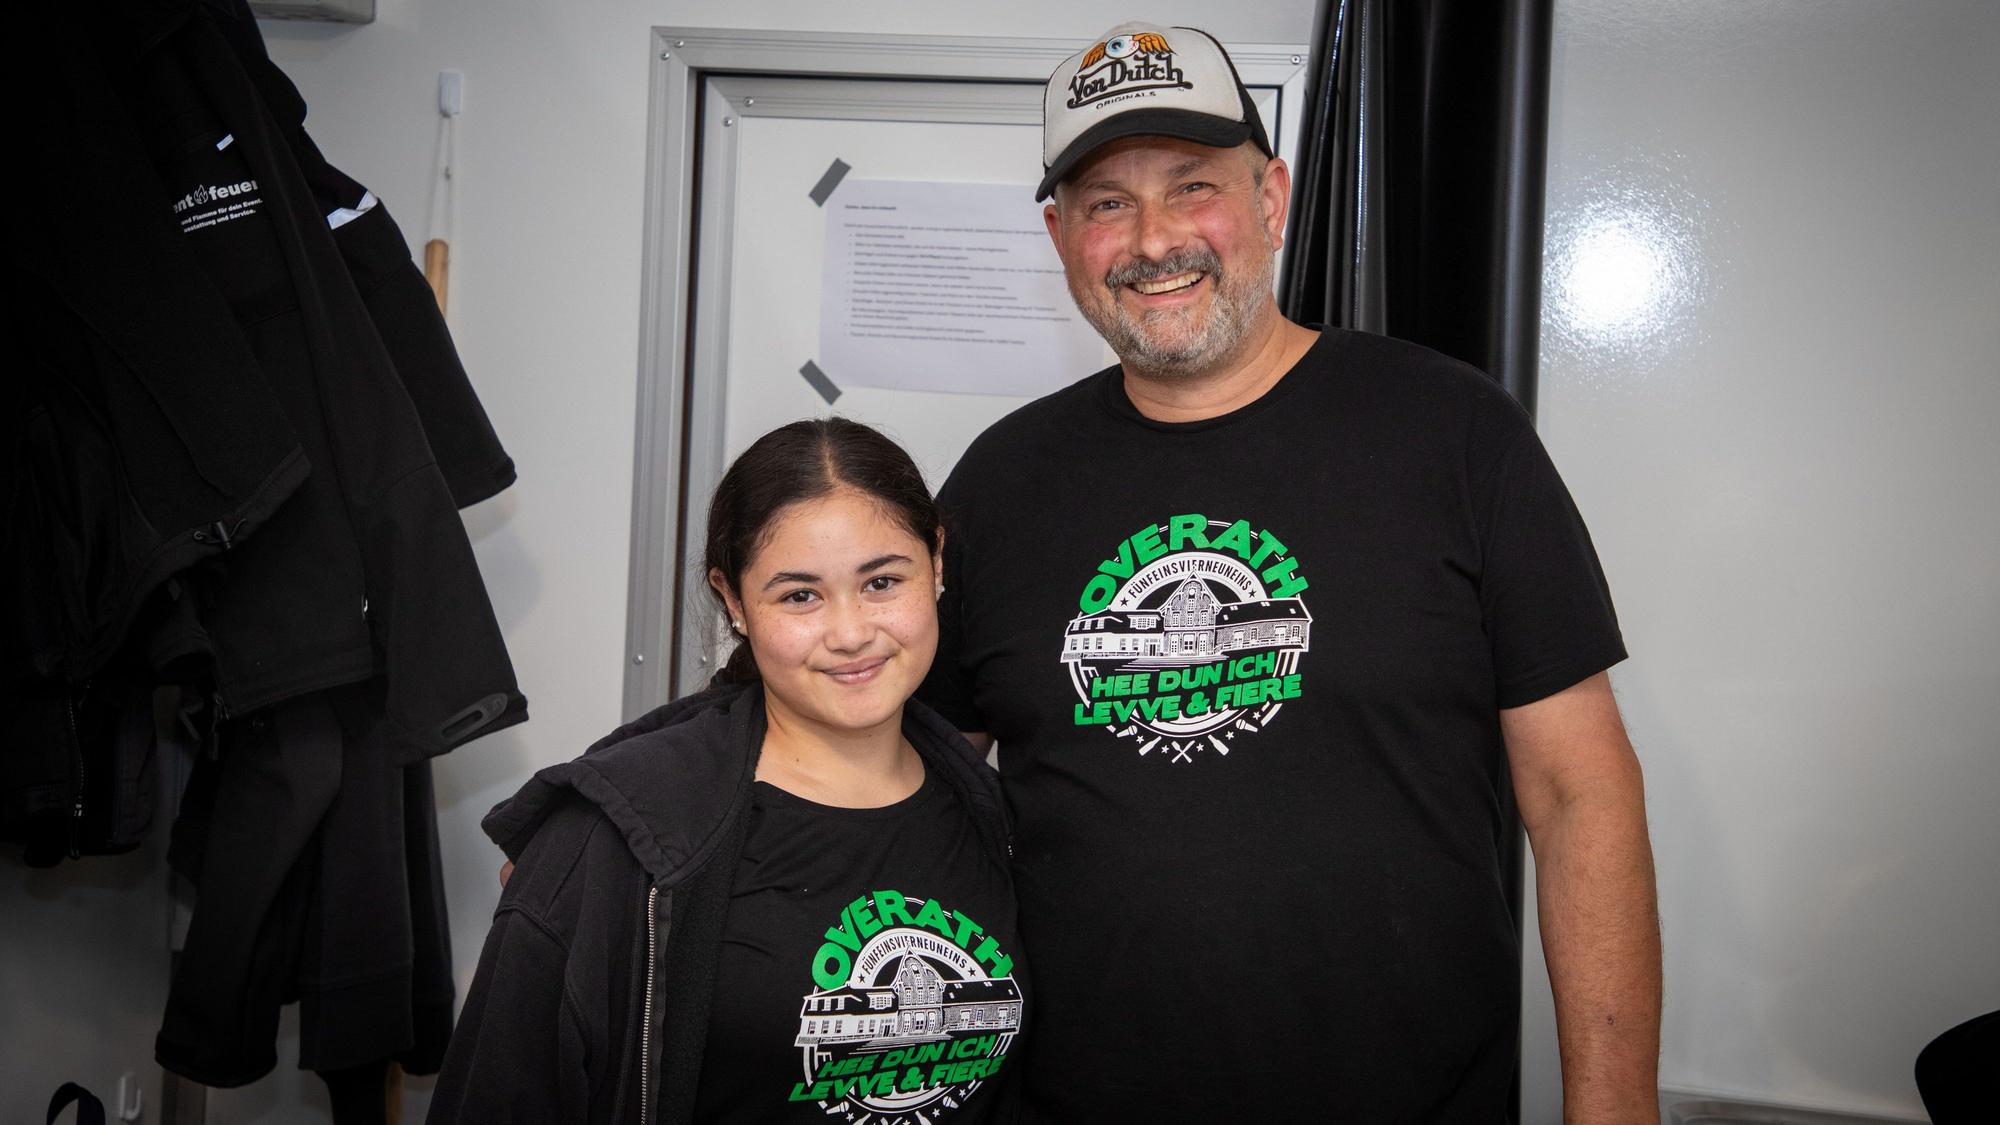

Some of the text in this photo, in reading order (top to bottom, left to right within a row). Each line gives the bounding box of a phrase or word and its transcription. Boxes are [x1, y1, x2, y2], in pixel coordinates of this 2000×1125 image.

[1067, 53, 1184, 104] Von Dutch
[1095, 91, 1156, 109] ORIGINALS
[192, 210, 217, 222] Flamme
[217, 207, 228, 215] für
[228, 204, 242, 212] dein
[242, 198, 263, 208] Event.
[217, 214, 229, 223] und
[229, 209, 256, 220] Service.
[1079, 513, 1309, 615] OVERATH
[1128, 559, 1253, 599] FÜNFEINSVIERNEUNEINS
[1091, 651, 1276, 698] HEE DUN ICH
[1074, 673, 1302, 726] LEVVE & FIERE
[811, 889, 1015, 991] OVERATH
[862, 935, 968, 975] FÜNFEINSVIERNEUNEINS
[788, 1055, 1007, 1102] LEVVE & FIERE
[817, 1034, 997, 1079] HEE DUN ICH
